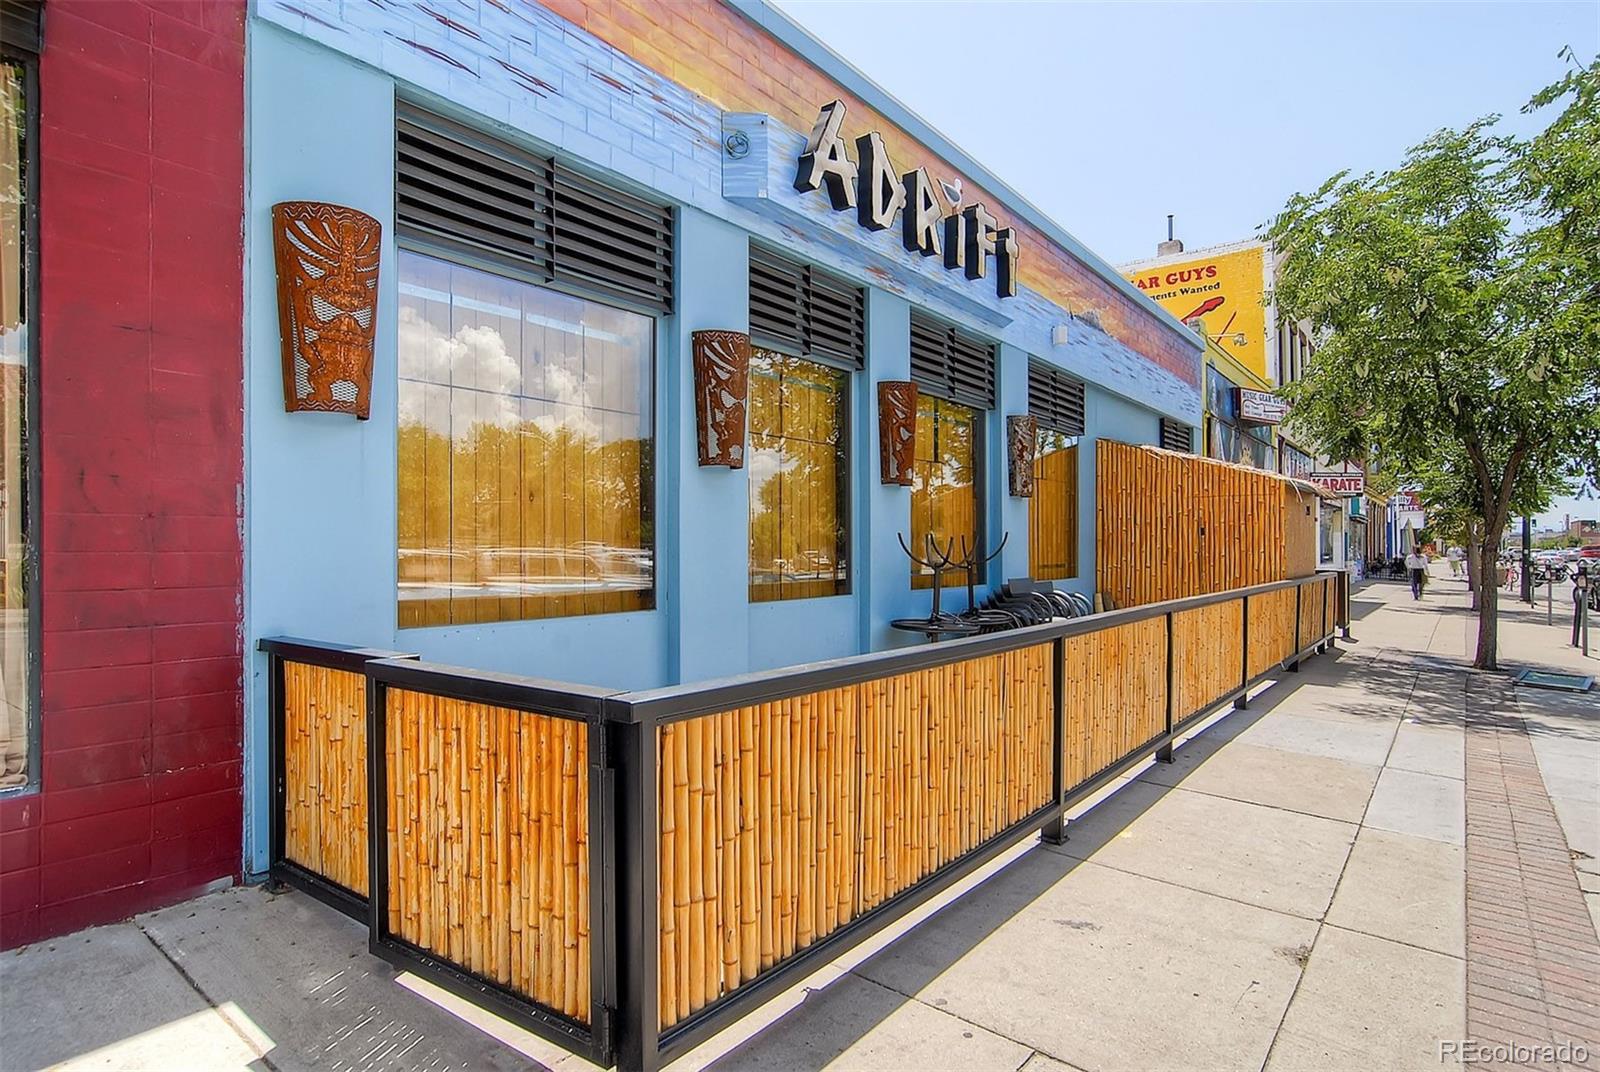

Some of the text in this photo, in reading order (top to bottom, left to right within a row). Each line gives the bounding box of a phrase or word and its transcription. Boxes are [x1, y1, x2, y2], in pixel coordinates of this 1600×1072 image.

[793, 99, 1019, 299] ADRIFT
[1165, 266, 1216, 284] GUYS
[1179, 282, 1221, 296] Wanted
[1242, 391, 1257, 400] MUSIC
[1258, 393, 1272, 403] GEAR
